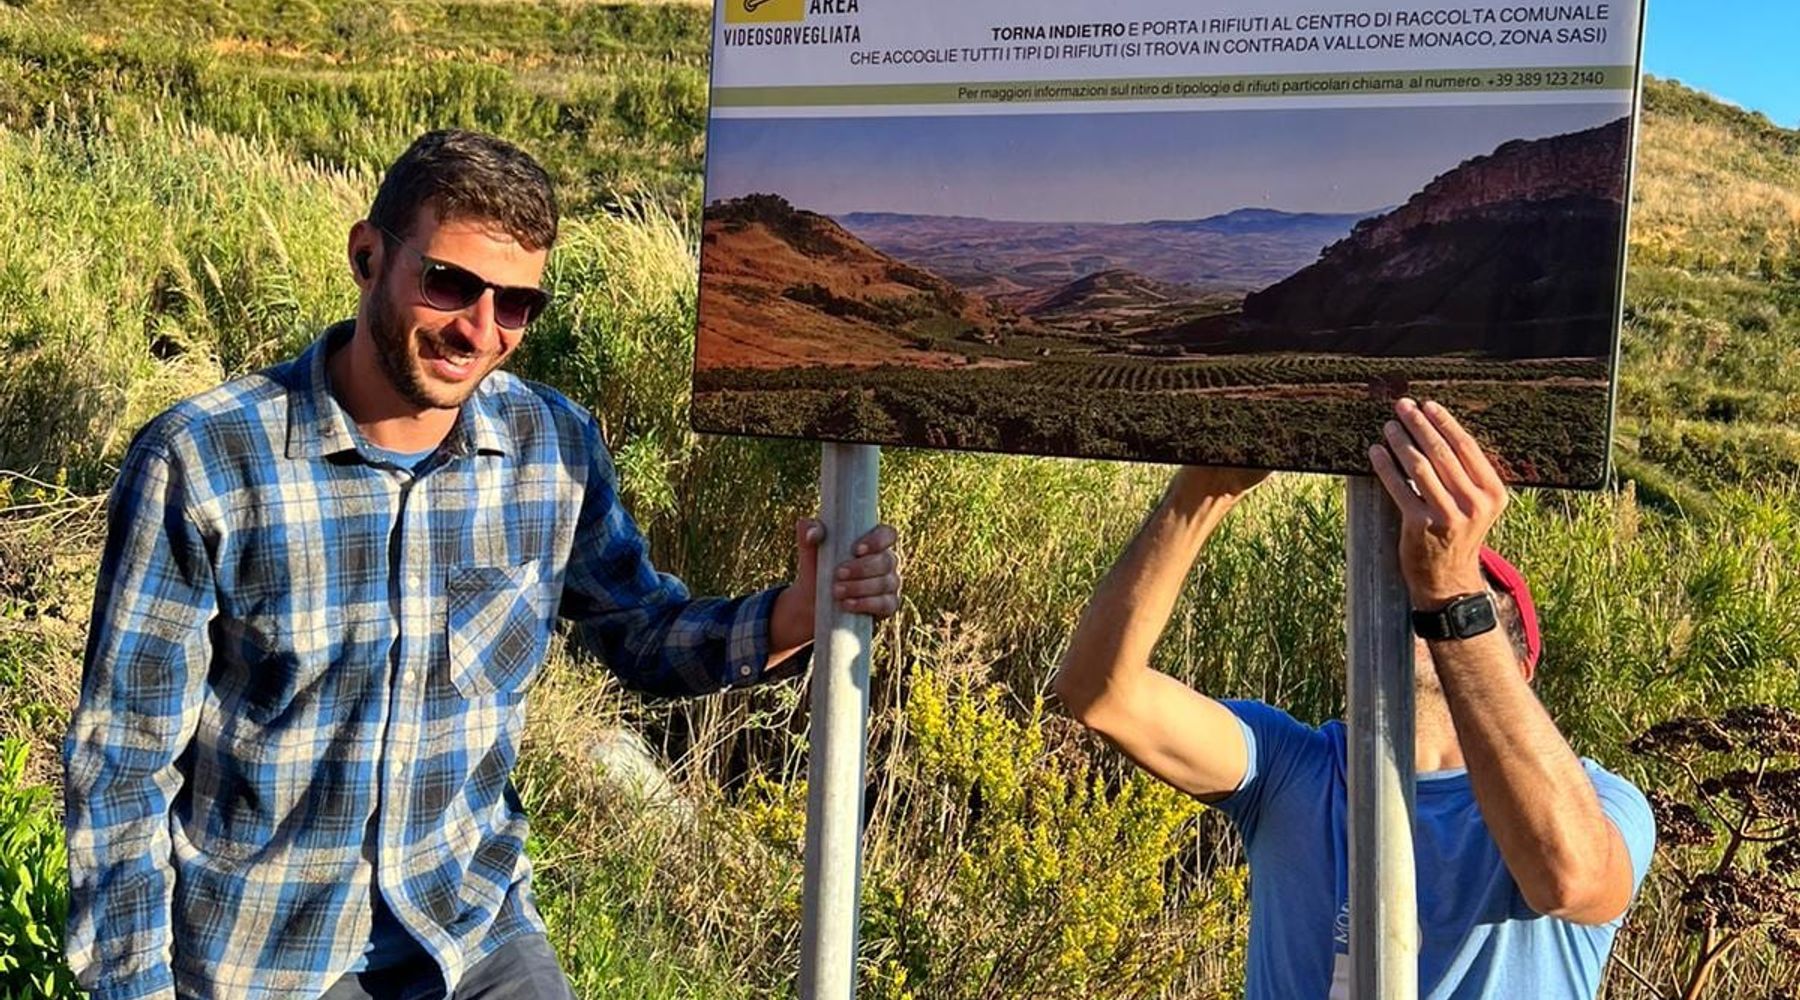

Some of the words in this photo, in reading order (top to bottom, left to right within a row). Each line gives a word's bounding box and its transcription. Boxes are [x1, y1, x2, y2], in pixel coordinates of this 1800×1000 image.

[809, 0, 859, 14] AREA
[991, 26, 1046, 41] TORNA
[1049, 22, 1126, 39] INDIETRO
[1128, 21, 1139, 36] E
[1142, 20, 1198, 36] PORTA
[1209, 17, 1269, 33] RIFIUTI
[1271, 17, 1293, 31] AL
[1295, 13, 1371, 31] CENTRO
[1374, 12, 1392, 28] DI
[1396, 8, 1496, 27] RACCOLTA
[1500, 4, 1609, 23] COMUNALE
[724, 25, 861, 46] VIDEOSORVEGLIATA
[850, 51, 880, 65] CHE
[882, 49, 958, 65] ACCOGLIE
[962, 47, 1004, 62] TUTTI
[1015, 45, 1041, 60] TIPI
[1044, 45, 1059, 59] DI
[1063, 43, 1118, 59] RIFIUTI
[1121, 42, 1141, 59] (SI
[1144, 40, 1200, 57] TROVA
[1203, 39, 1220, 54] IN
[1223, 36, 1320, 54] CONTRADA
[1323, 33, 1405, 51] VALLONE
[1408, 30, 1496, 47] MONACO,
[1500, 29, 1553, 45] ZONA
[1556, 27, 1607, 44] SASI)
[958, 86, 979, 99] Per
[980, 87, 1032, 102] maggiori
[1034, 84, 1108, 98] informazioni
[1110, 83, 1129, 95] sul
[1131, 83, 1159, 95] ritiro
[1161, 81, 1173, 94] di
[1175, 80, 1231, 97] tipologie
[1232, 79, 1244, 93] di
[1247, 79, 1280, 93] rifiuti
[1282, 77, 1349, 94] particolari
[1351, 75, 1404, 90] chiama
[1408, 75, 1422, 89] al
[1487, 72, 1513, 87] +39
[1516, 72, 1542, 87] 389
[1546, 71, 1568, 86] 123
[1570, 71, 1605, 86] 2140
